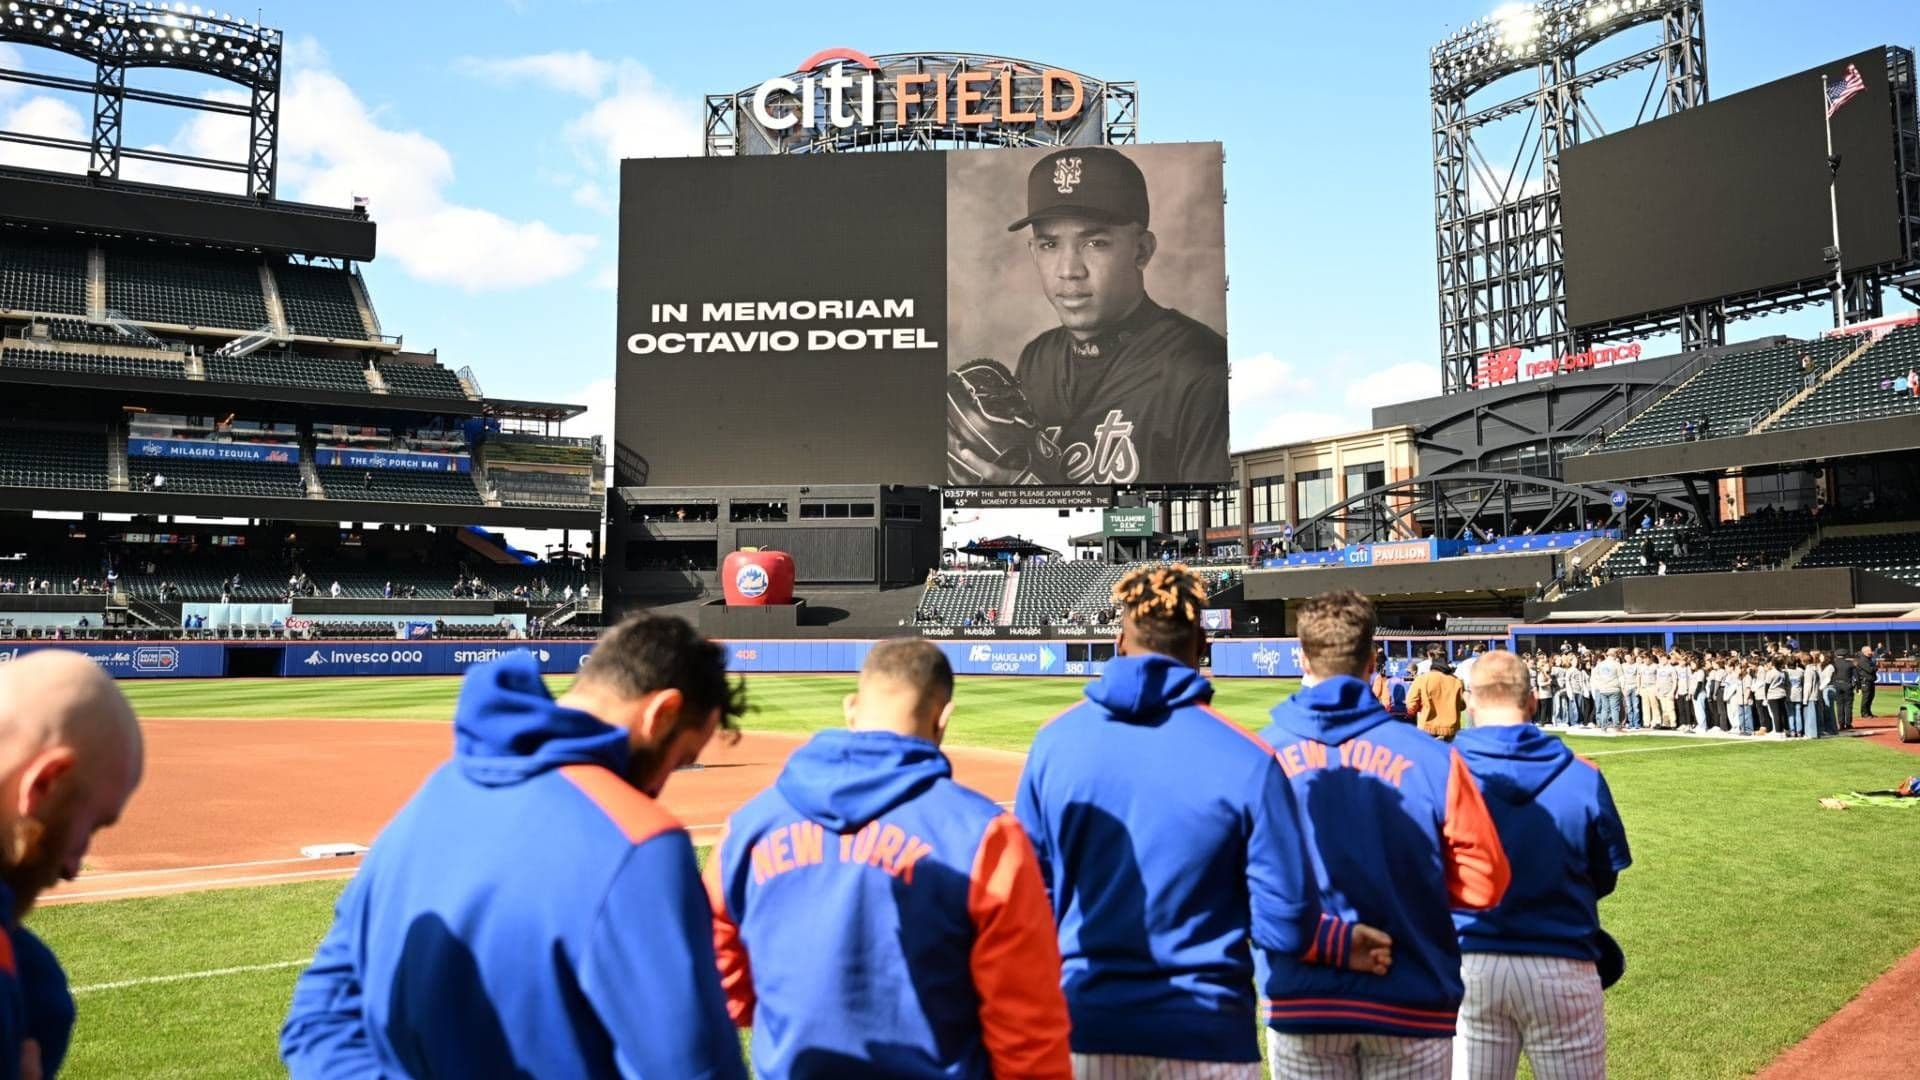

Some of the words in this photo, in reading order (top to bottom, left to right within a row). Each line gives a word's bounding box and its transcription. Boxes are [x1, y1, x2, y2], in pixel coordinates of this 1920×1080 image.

[753, 62, 874, 129] citi
[896, 69, 1084, 126] FIELD
[651, 303, 688, 323] IN
[702, 299, 914, 322] MEMORIAM
[627, 331, 800, 354] OCTAVIO
[807, 328, 939, 351] DOTEL
[1525, 360, 1559, 377] new
[1564, 343, 1642, 371] balance
[170, 447, 215, 457] MILAGRO
[218, 449, 260, 459] TEQUILA
[350, 456, 367, 465] THE
[1375, 548, 1425, 561] PAVILION
[330, 651, 389, 663] Invesco
[391, 651, 423, 663] QQQ
[992, 654, 1037, 662] HAUGLAND
[1065, 663, 1084, 674] 380
[1338, 739, 1414, 788] YORK
[750, 820, 824, 885] NEW
